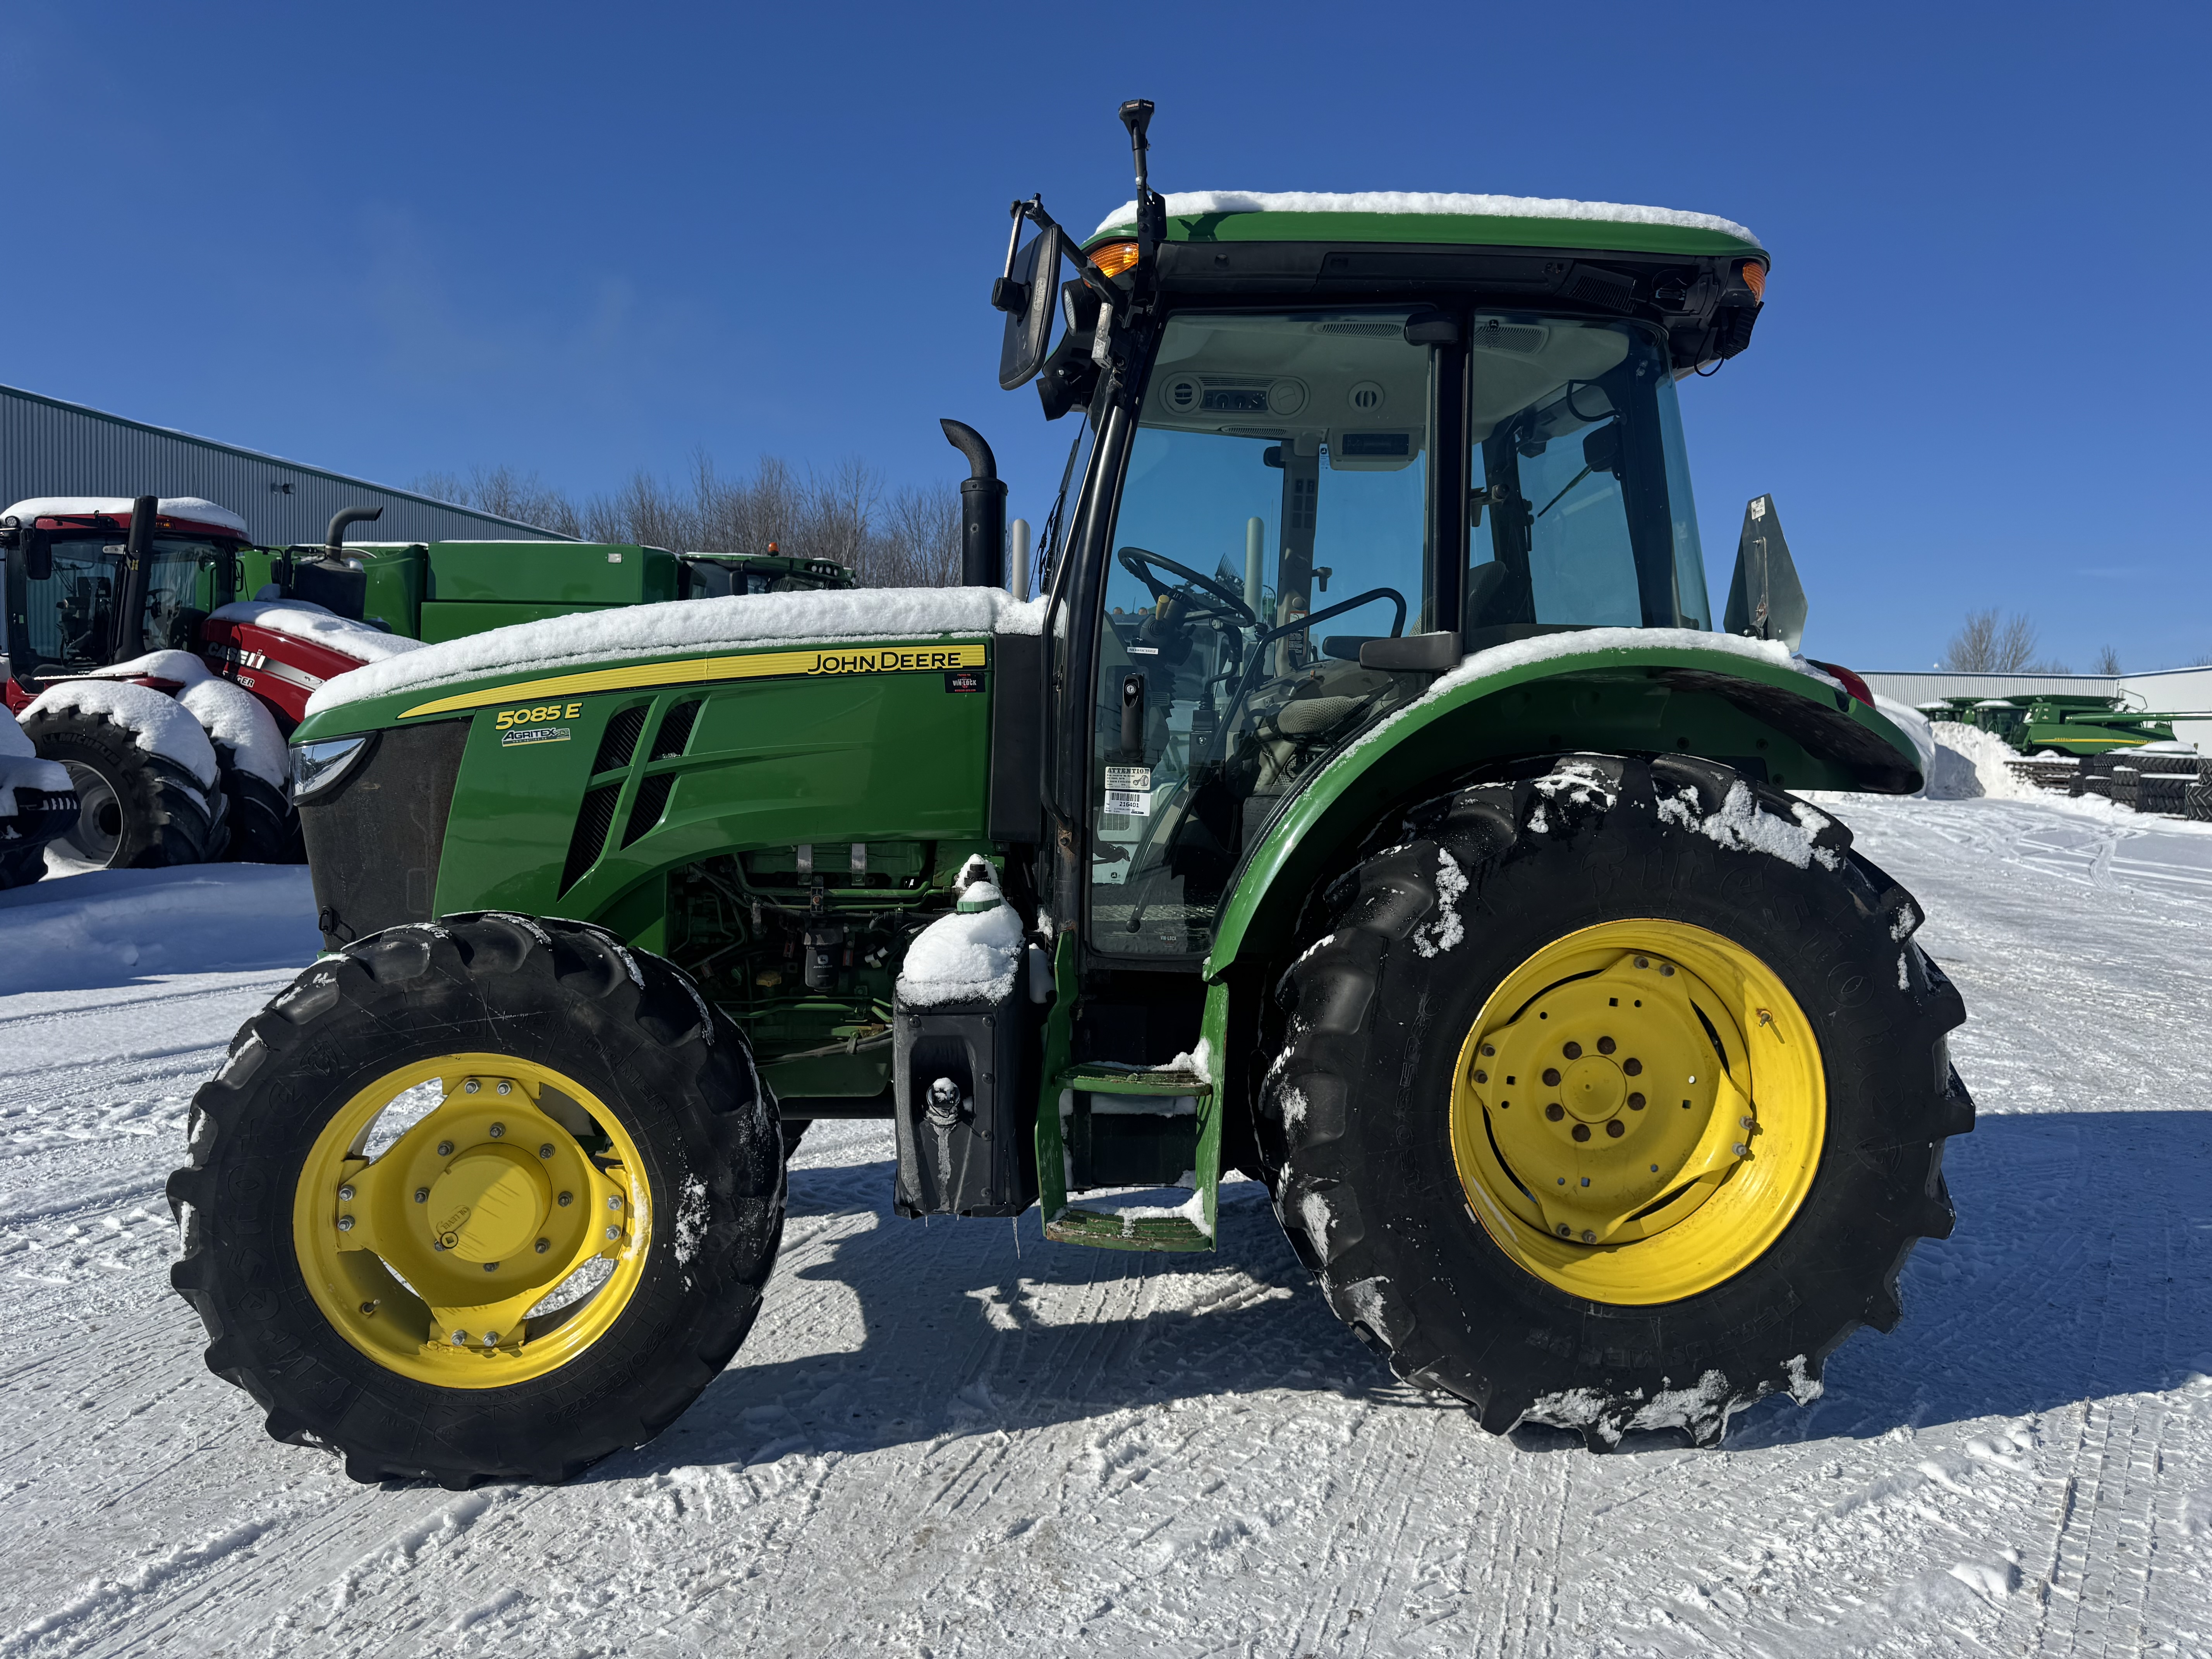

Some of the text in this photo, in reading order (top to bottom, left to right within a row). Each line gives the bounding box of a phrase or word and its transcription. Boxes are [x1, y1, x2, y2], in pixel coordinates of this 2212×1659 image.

[208, 642, 249, 665] CASE
[808, 652, 961, 672] JOHN DEERE
[495, 702, 582, 730] 5085 E
[503, 728, 555, 740] AGRITEX
[544, 1321, 670, 1426] 320/85R24
